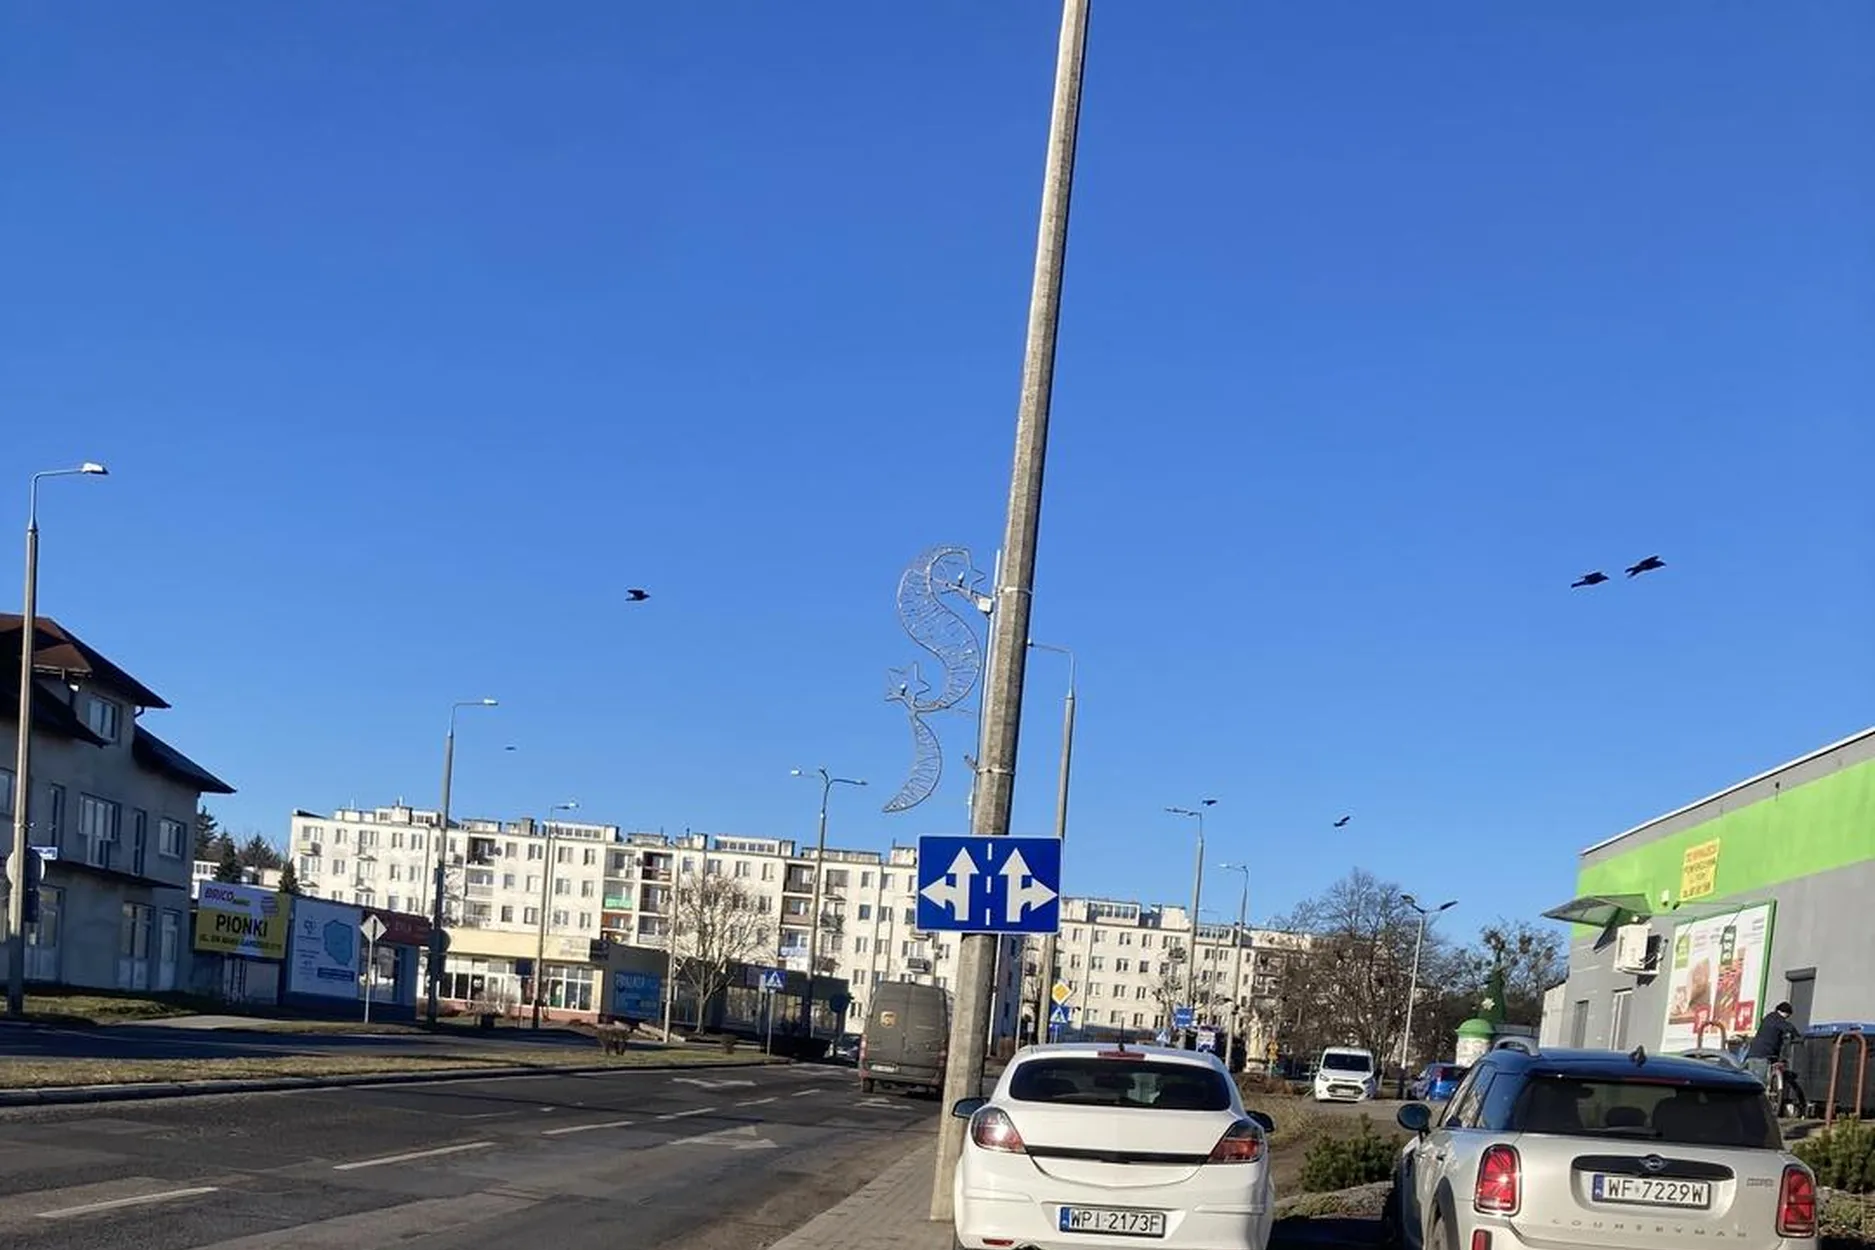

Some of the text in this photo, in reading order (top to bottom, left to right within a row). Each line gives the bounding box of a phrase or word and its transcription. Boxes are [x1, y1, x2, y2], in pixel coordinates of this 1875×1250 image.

[216, 913, 268, 937] PIONKI
[1608, 1179, 1704, 1203] WF 7229W
[1070, 1209, 1161, 1232] WPI 2173F
